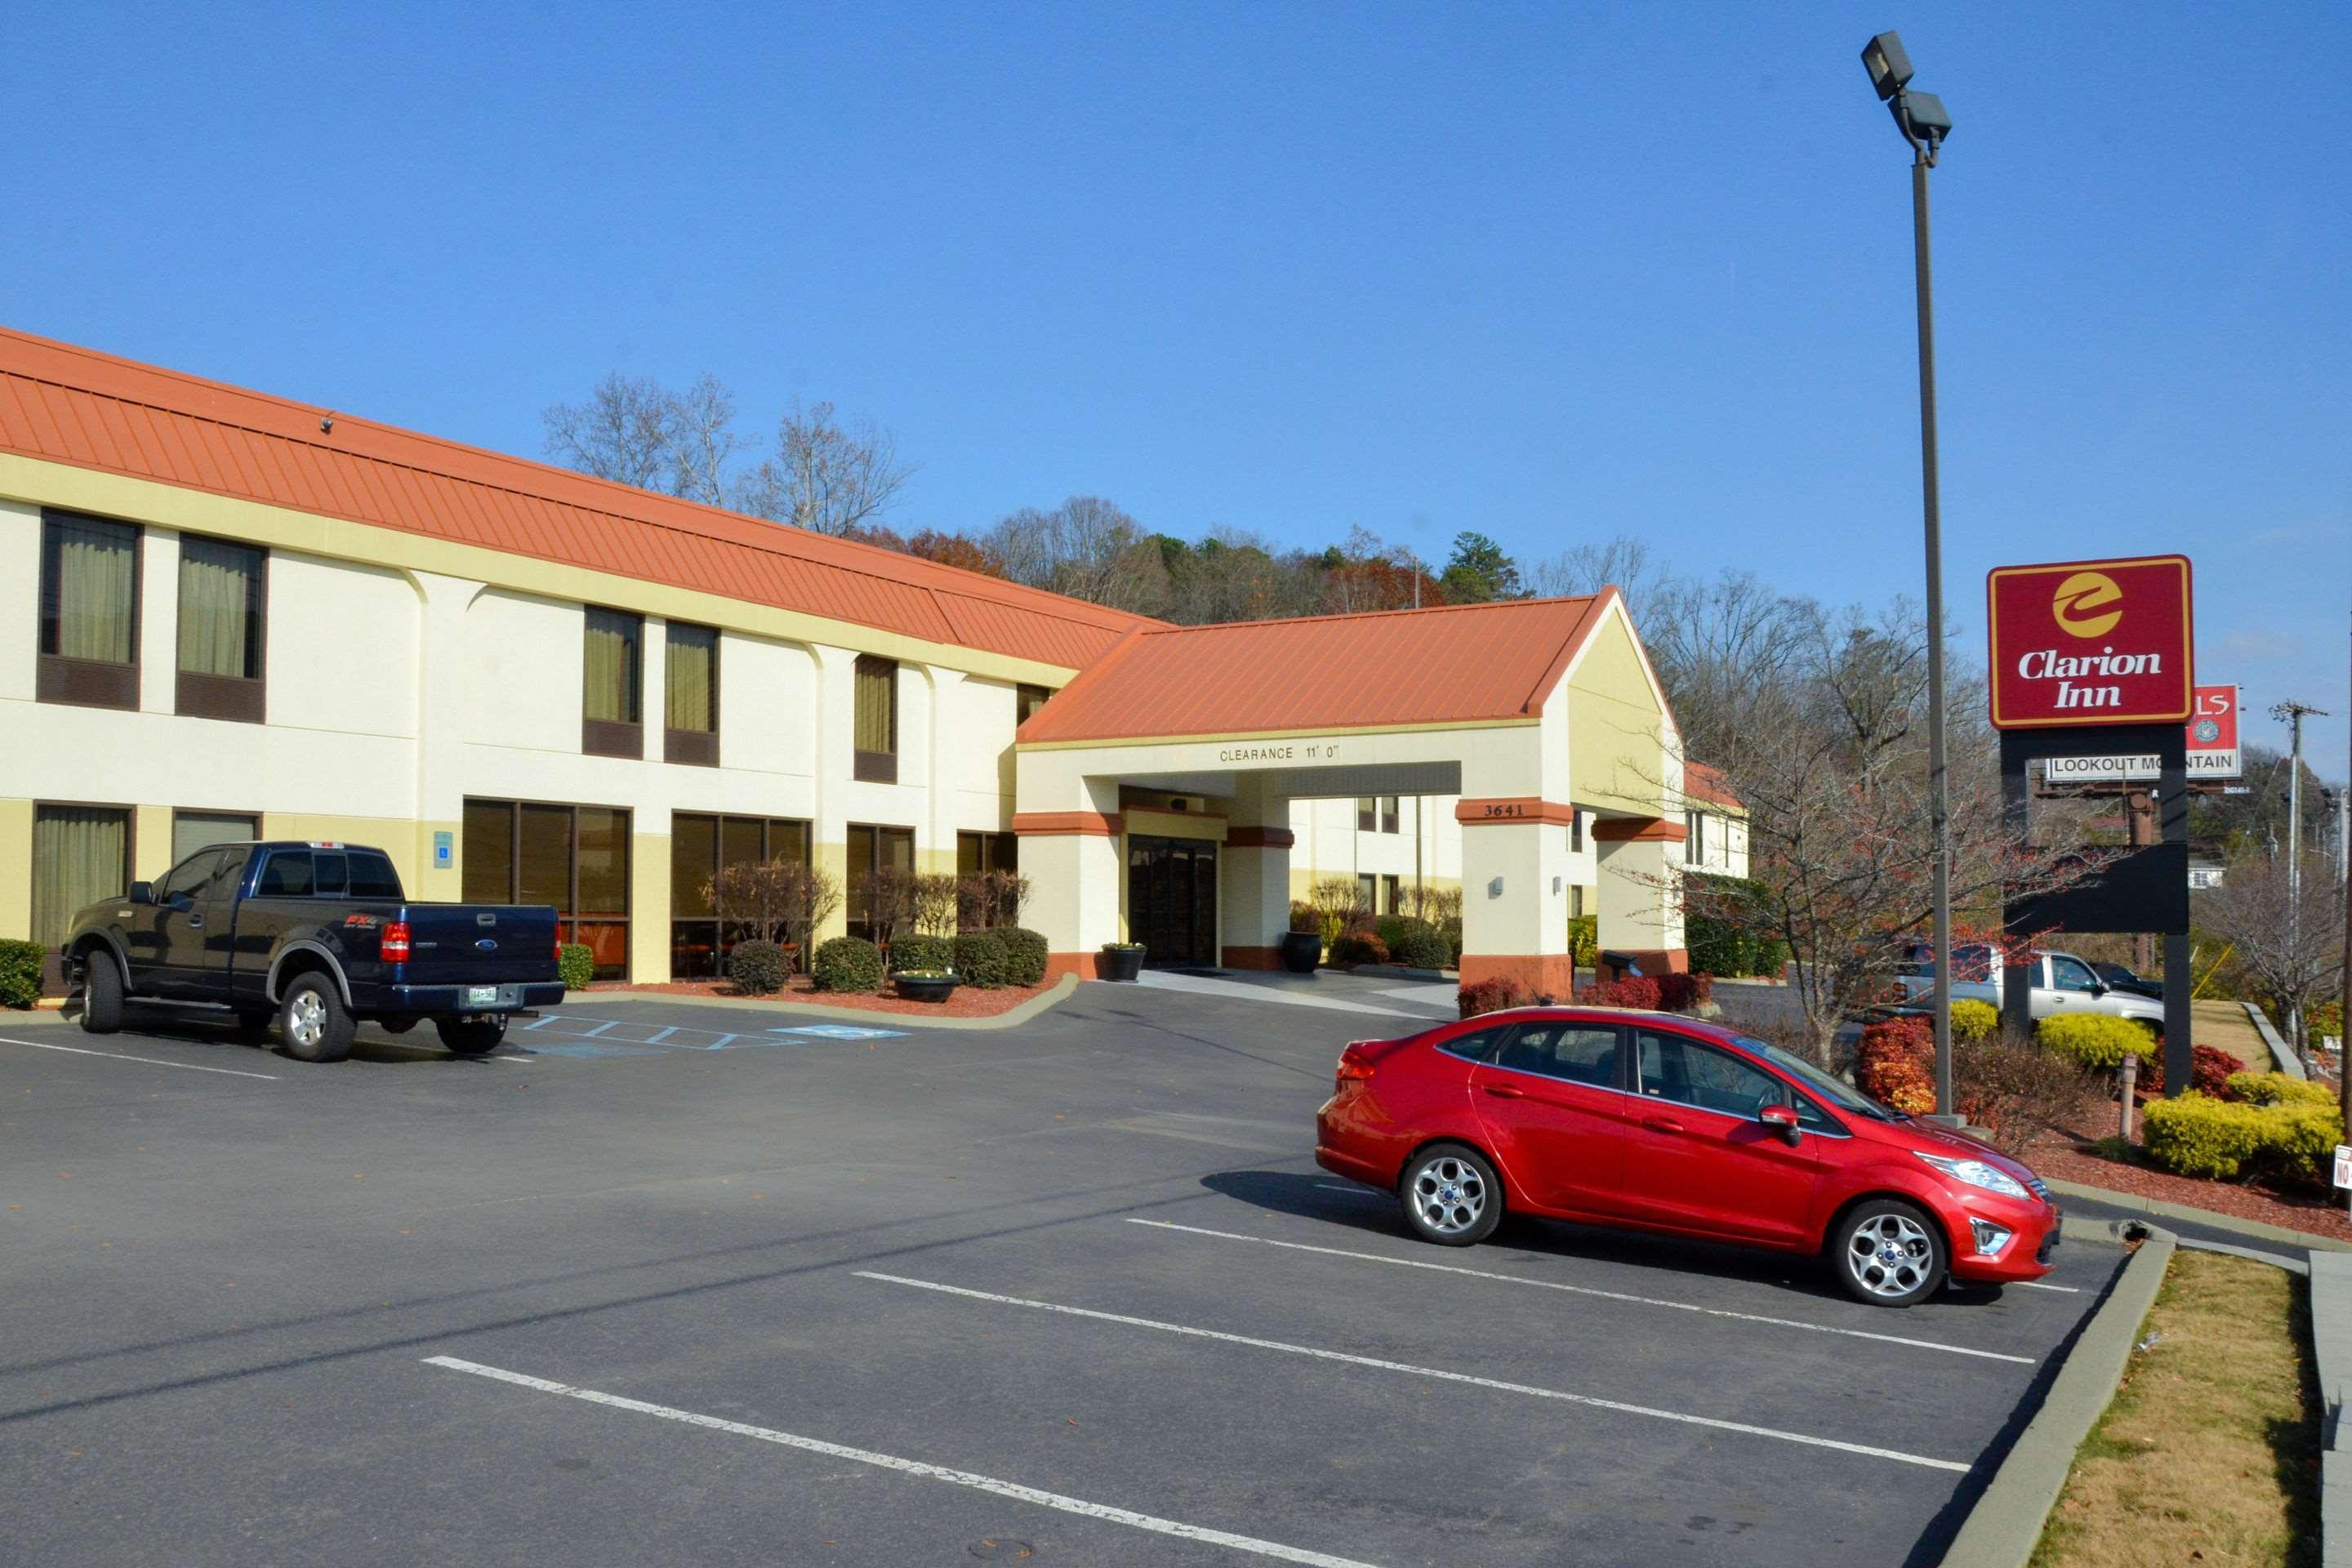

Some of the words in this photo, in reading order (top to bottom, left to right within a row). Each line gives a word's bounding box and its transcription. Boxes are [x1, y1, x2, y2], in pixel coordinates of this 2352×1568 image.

[2018, 646, 2163, 679] Clarion
[2053, 681, 2122, 708] Inn
[1220, 746, 1294, 761] CLEARANCE
[2055, 757, 2136, 772] LOOKOUT
[2142, 755, 2232, 769] MONTAIN
[1484, 804, 1524, 817] 3641
